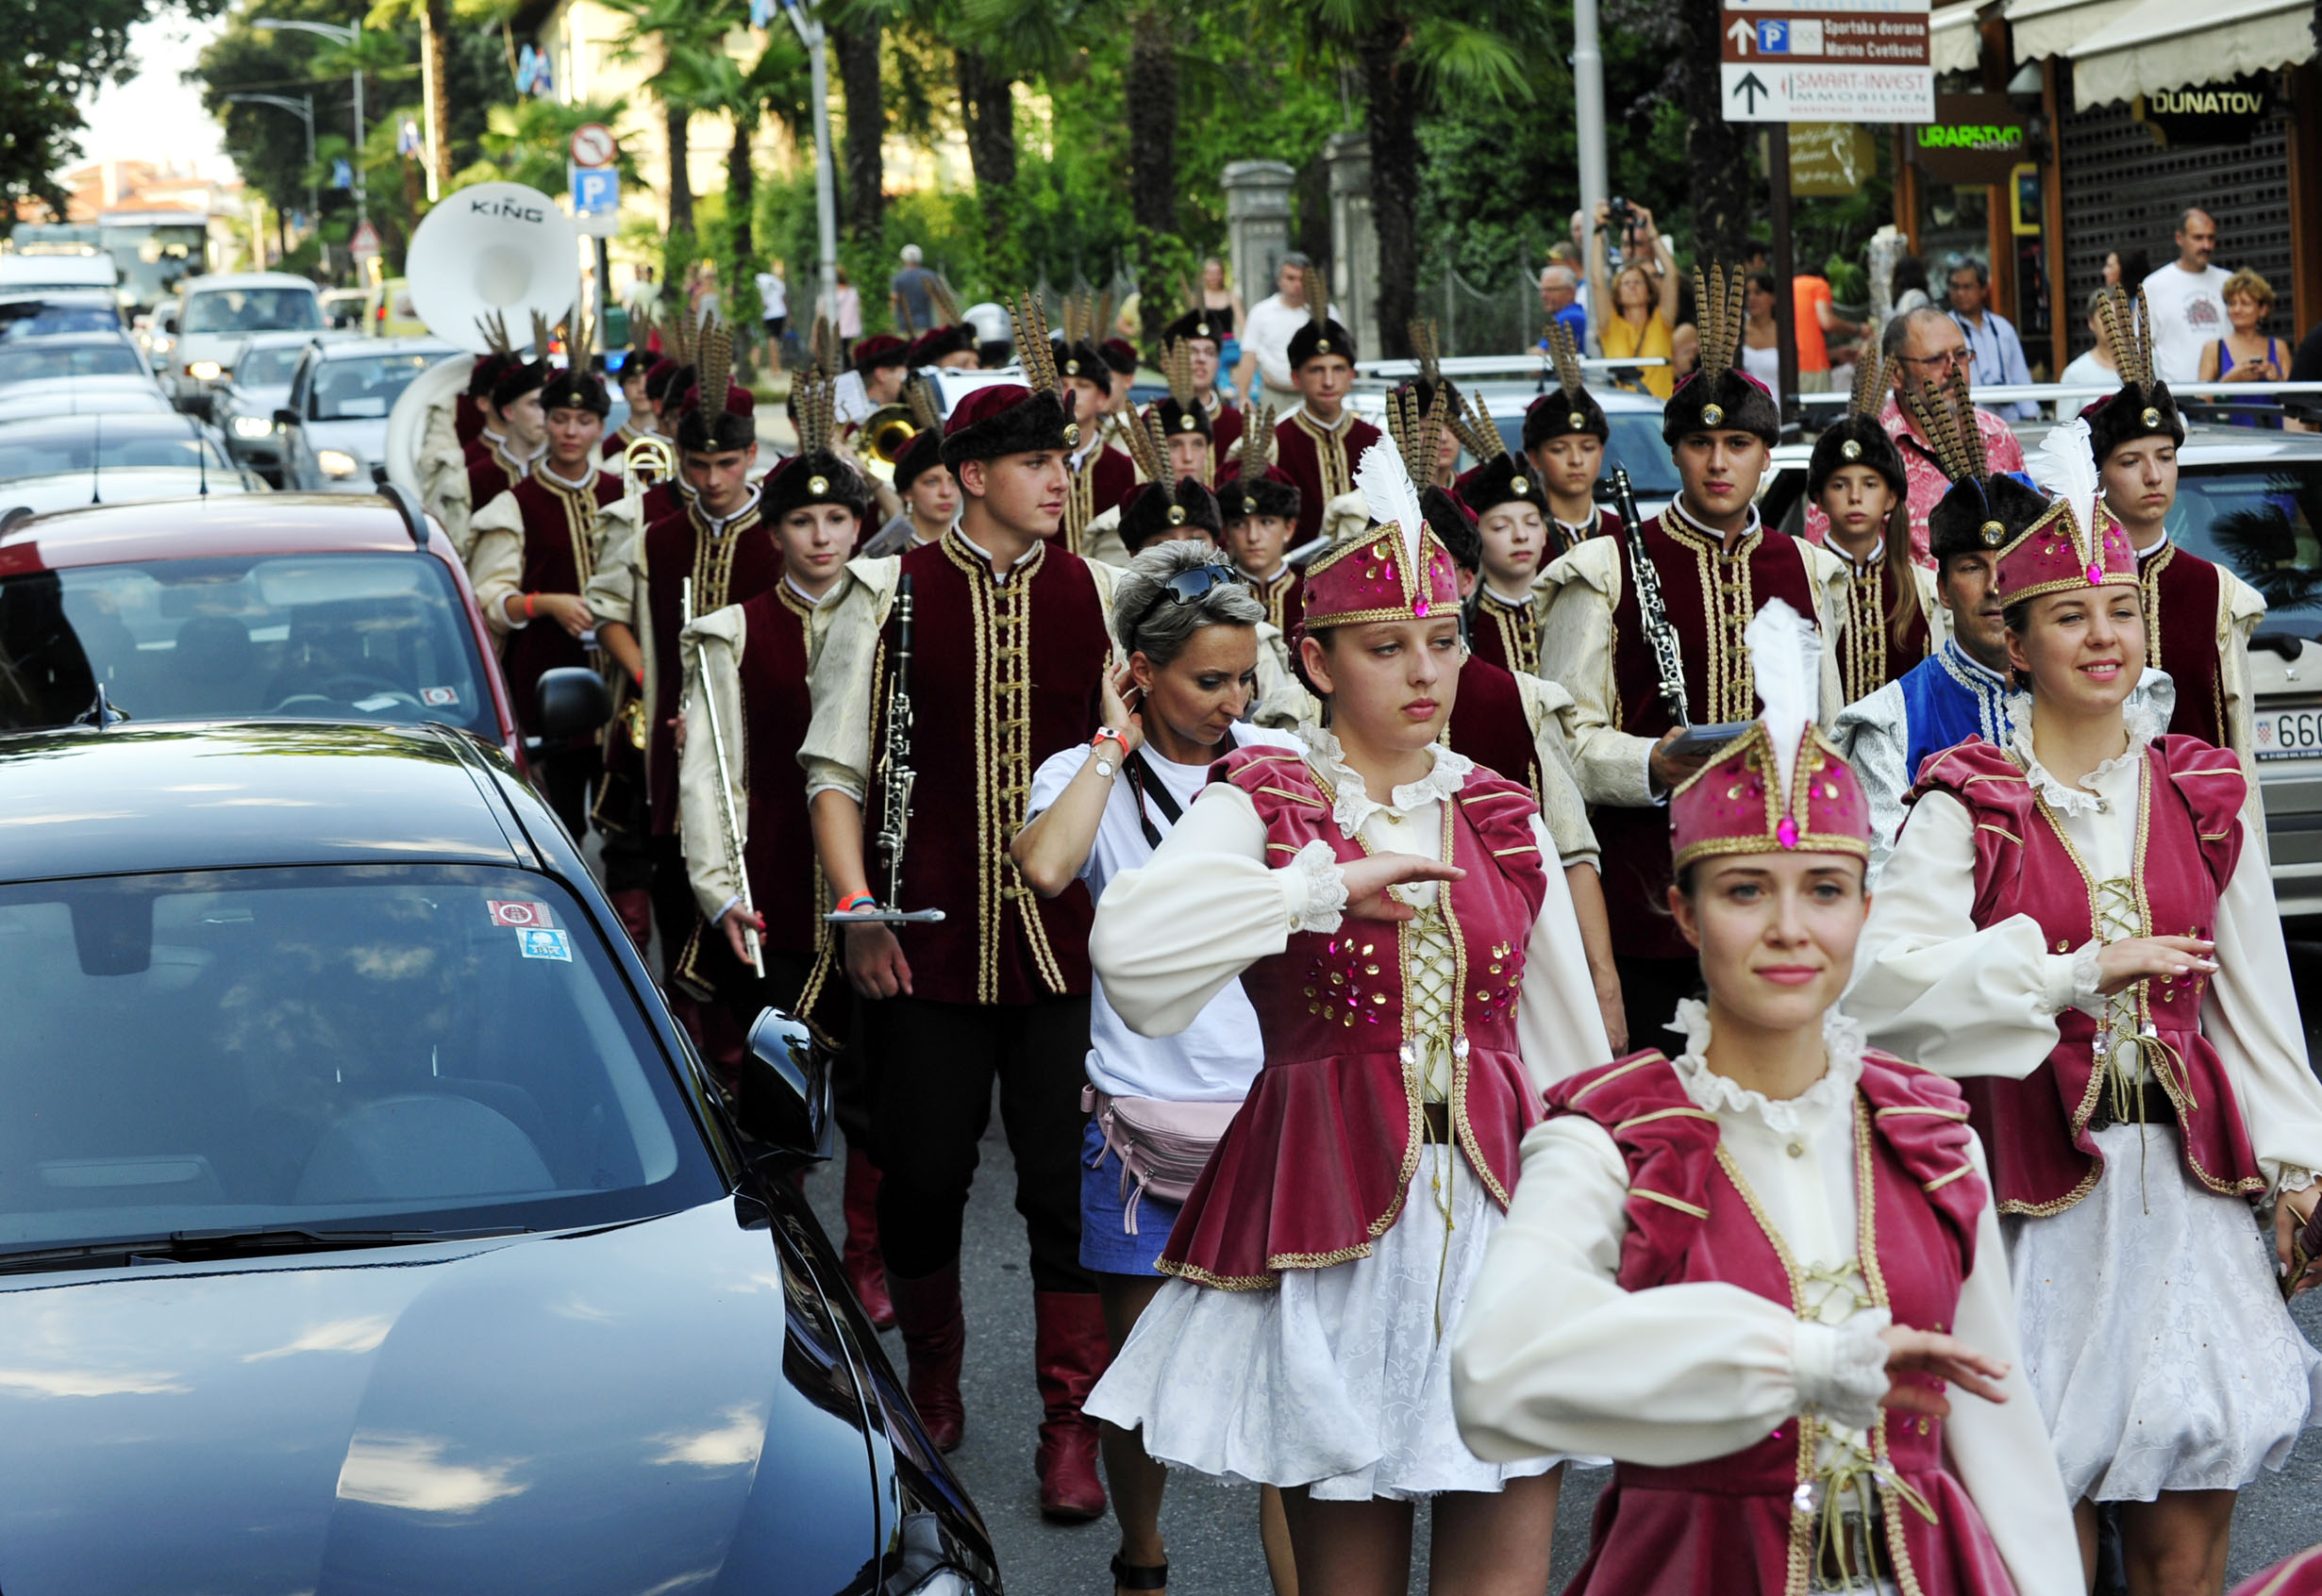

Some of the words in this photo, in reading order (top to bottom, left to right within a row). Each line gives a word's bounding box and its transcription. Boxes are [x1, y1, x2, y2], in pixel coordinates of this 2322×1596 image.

[1824, 19, 1877, 37] Sportska
[1879, 21, 1925, 36] dvorana
[1796, 73, 1925, 91] SMART-INVEST
[2152, 91, 2263, 113] DUNATOV
[471, 200, 543, 224] KING
